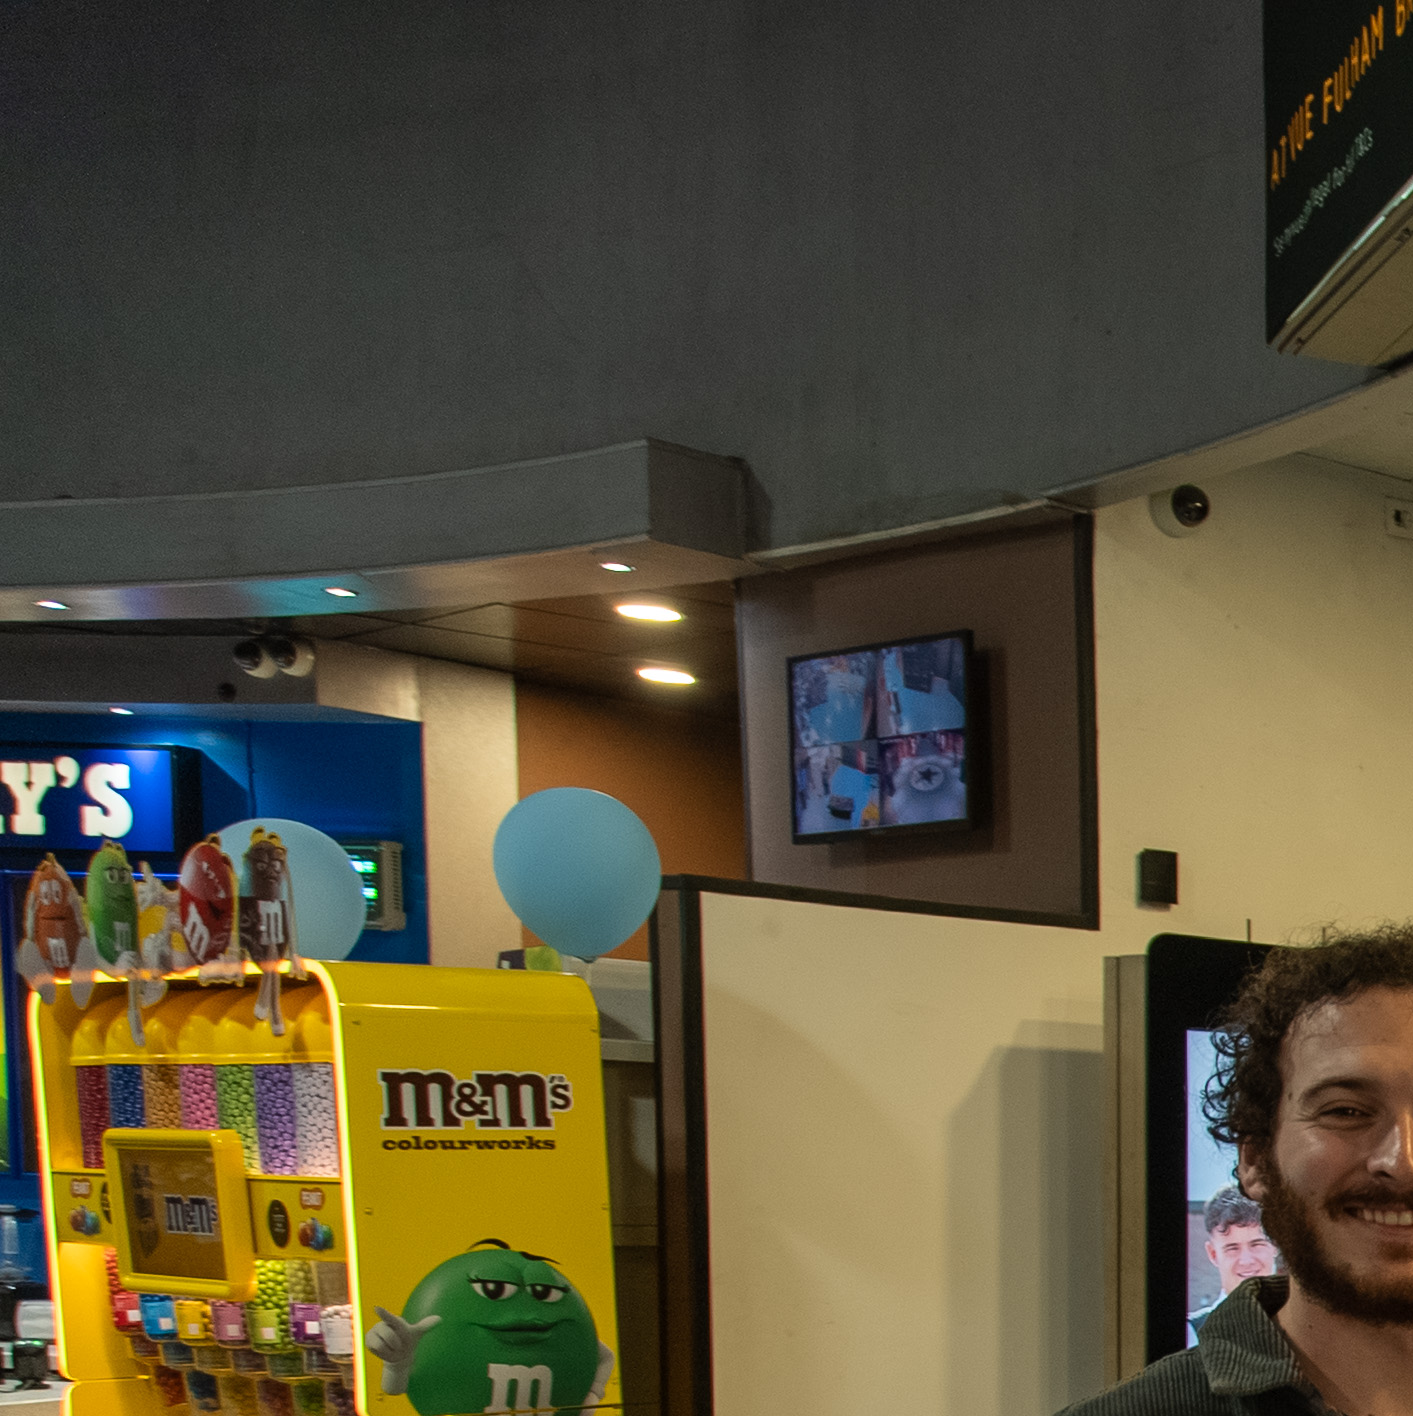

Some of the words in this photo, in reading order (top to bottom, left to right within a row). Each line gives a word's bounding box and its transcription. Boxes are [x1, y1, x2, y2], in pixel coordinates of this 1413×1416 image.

[1287, 92, 1316, 162] VUE
[1321, 4, 1385, 125] FULHAM
[0, 755, 134, 839] Y'S
[382, 1135, 556, 1151] colourworks
